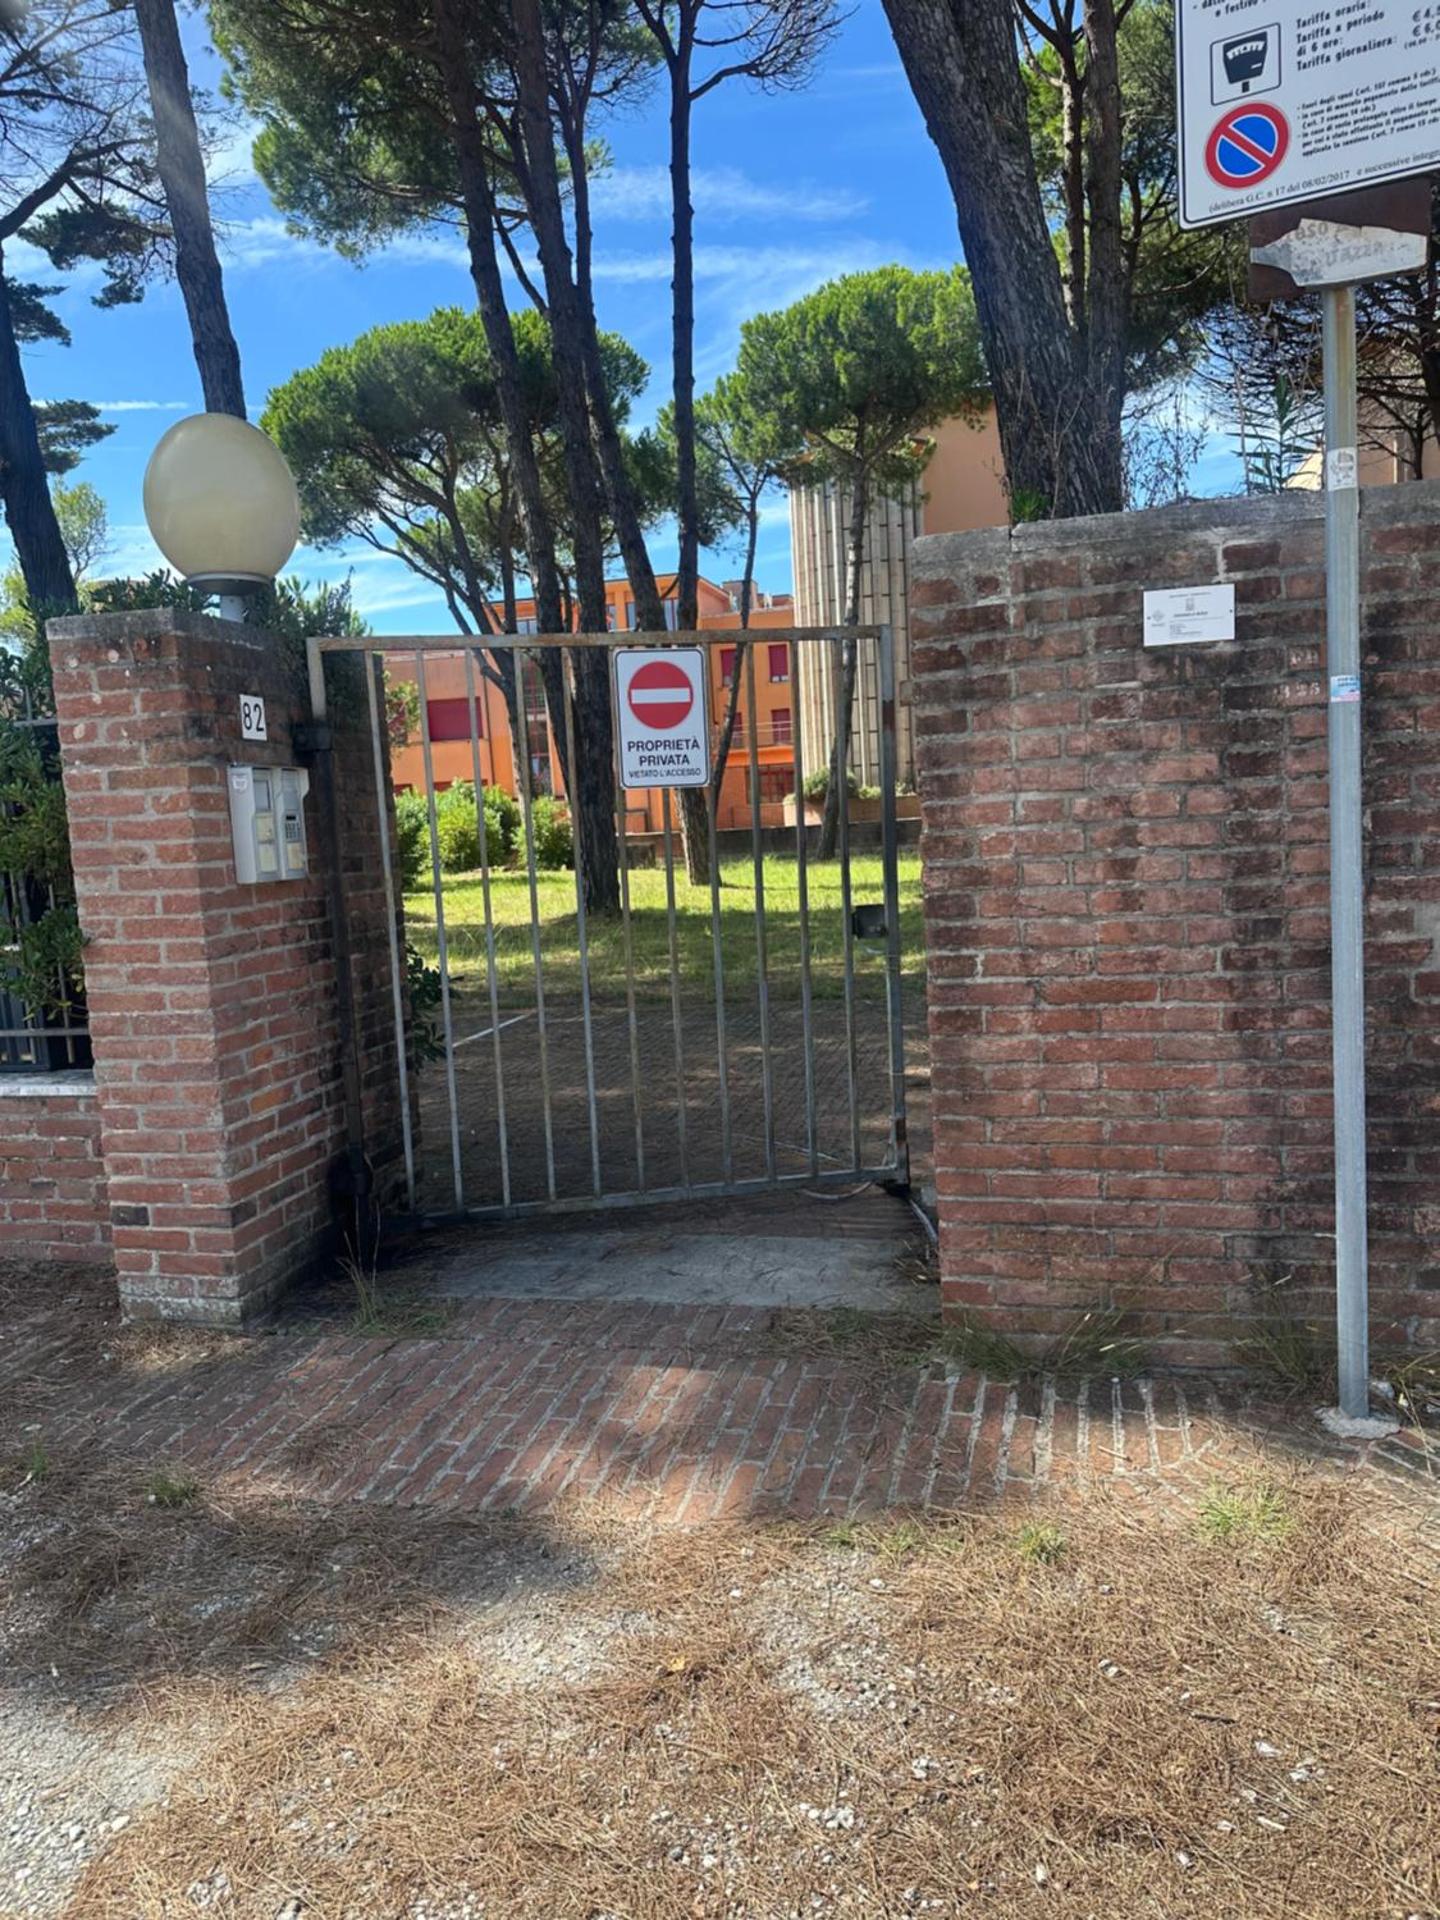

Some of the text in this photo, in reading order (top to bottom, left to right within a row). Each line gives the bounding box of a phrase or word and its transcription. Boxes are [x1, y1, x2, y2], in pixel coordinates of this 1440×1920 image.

[1296, 10, 1330, 29] Tariffa
[1412, 10, 1420, 22] €
[1296, 10, 1384, 44] Tariffa a periodo
[1412, 24, 1421, 38] €
[1297, 44, 1306, 56] di
[1312, 42, 1318, 52] 6
[1297, 54, 1330, 71] Tariffa
[1275, 187, 1286, 197] 17
[243, 702, 264, 731] 82
[628, 736, 700, 752] PROPRIETÀ
[639, 754, 690, 766] PRIVATA
[629, 769, 658, 778] VIETATO
